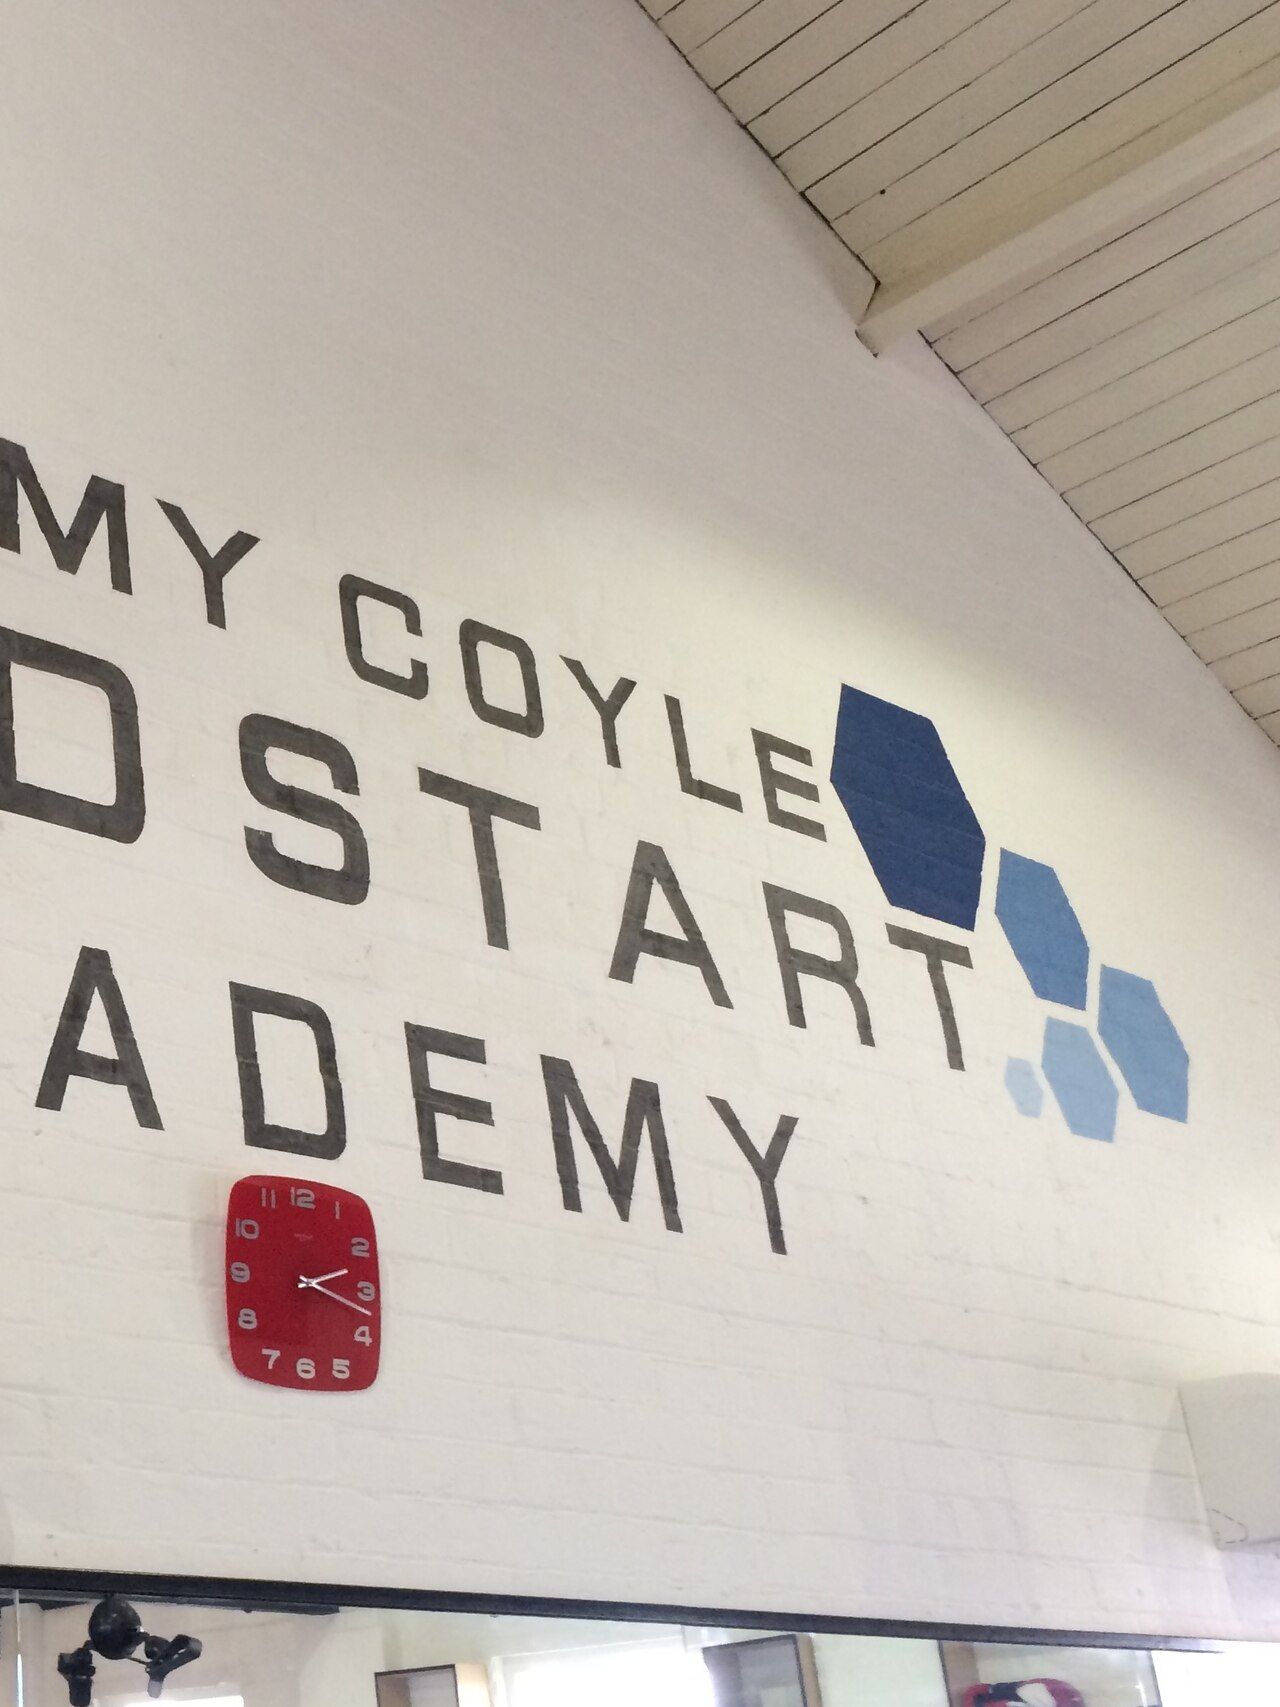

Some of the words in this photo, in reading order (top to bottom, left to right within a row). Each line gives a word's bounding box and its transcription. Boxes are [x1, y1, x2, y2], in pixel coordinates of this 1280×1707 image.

[339, 574, 826, 842] COYLE
[261, 1188, 276, 1208] 11
[290, 1187, 315, 1209] 12
[235, 1218, 259, 1239] 10
[351, 1238, 369, 1257] 2
[231, 1262, 250, 1283] 9
[357, 1281, 374, 1301] 3
[238, 1309, 257, 1329] 8
[354, 1326, 372, 1346] 4
[262, 1349, 280, 1369] 7
[296, 1358, 316, 1379] 6
[332, 1359, 350, 1379] 5
